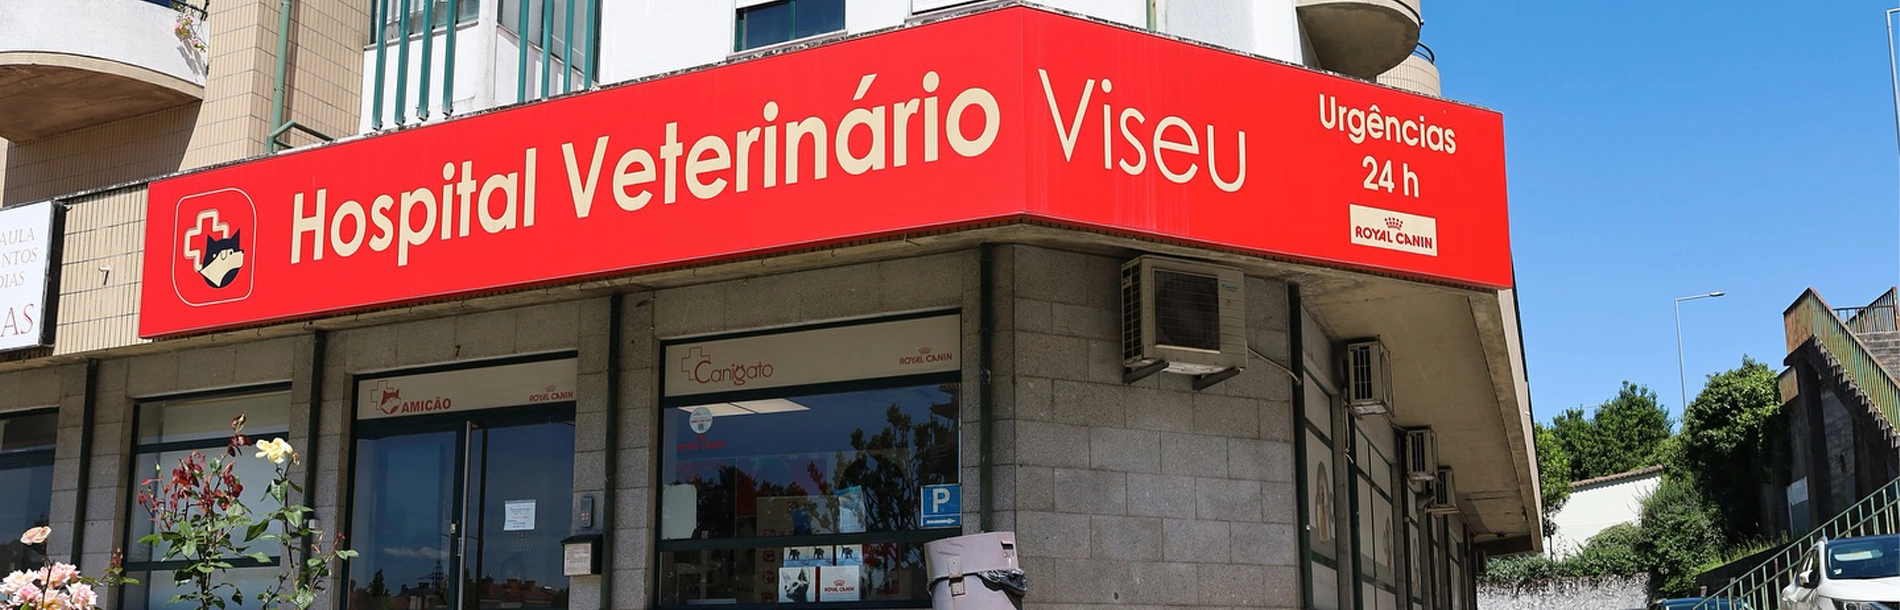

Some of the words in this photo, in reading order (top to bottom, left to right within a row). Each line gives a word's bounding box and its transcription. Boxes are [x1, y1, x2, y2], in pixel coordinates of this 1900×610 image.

[1037, 68, 1247, 192] Viseu
[1319, 93, 1457, 154] Urgências
[291, 147, 537, 266] Hospital
[561, 70, 1001, 219] Veterinário
[1362, 155, 1395, 193] 24
[1402, 163, 1419, 198] h
[1355, 225, 1393, 243] ROYAL
[1395, 232, 1433, 249] CANIN
[899, 356, 925, 365] ROYAL
[925, 353, 953, 363] CANIN
[694, 360, 774, 386] Canigato
[401, 396, 451, 413] AMICÃO
[528, 393, 550, 402] ROYAL
[550, 391, 573, 400] CANIN
[932, 488, 950, 512] P
